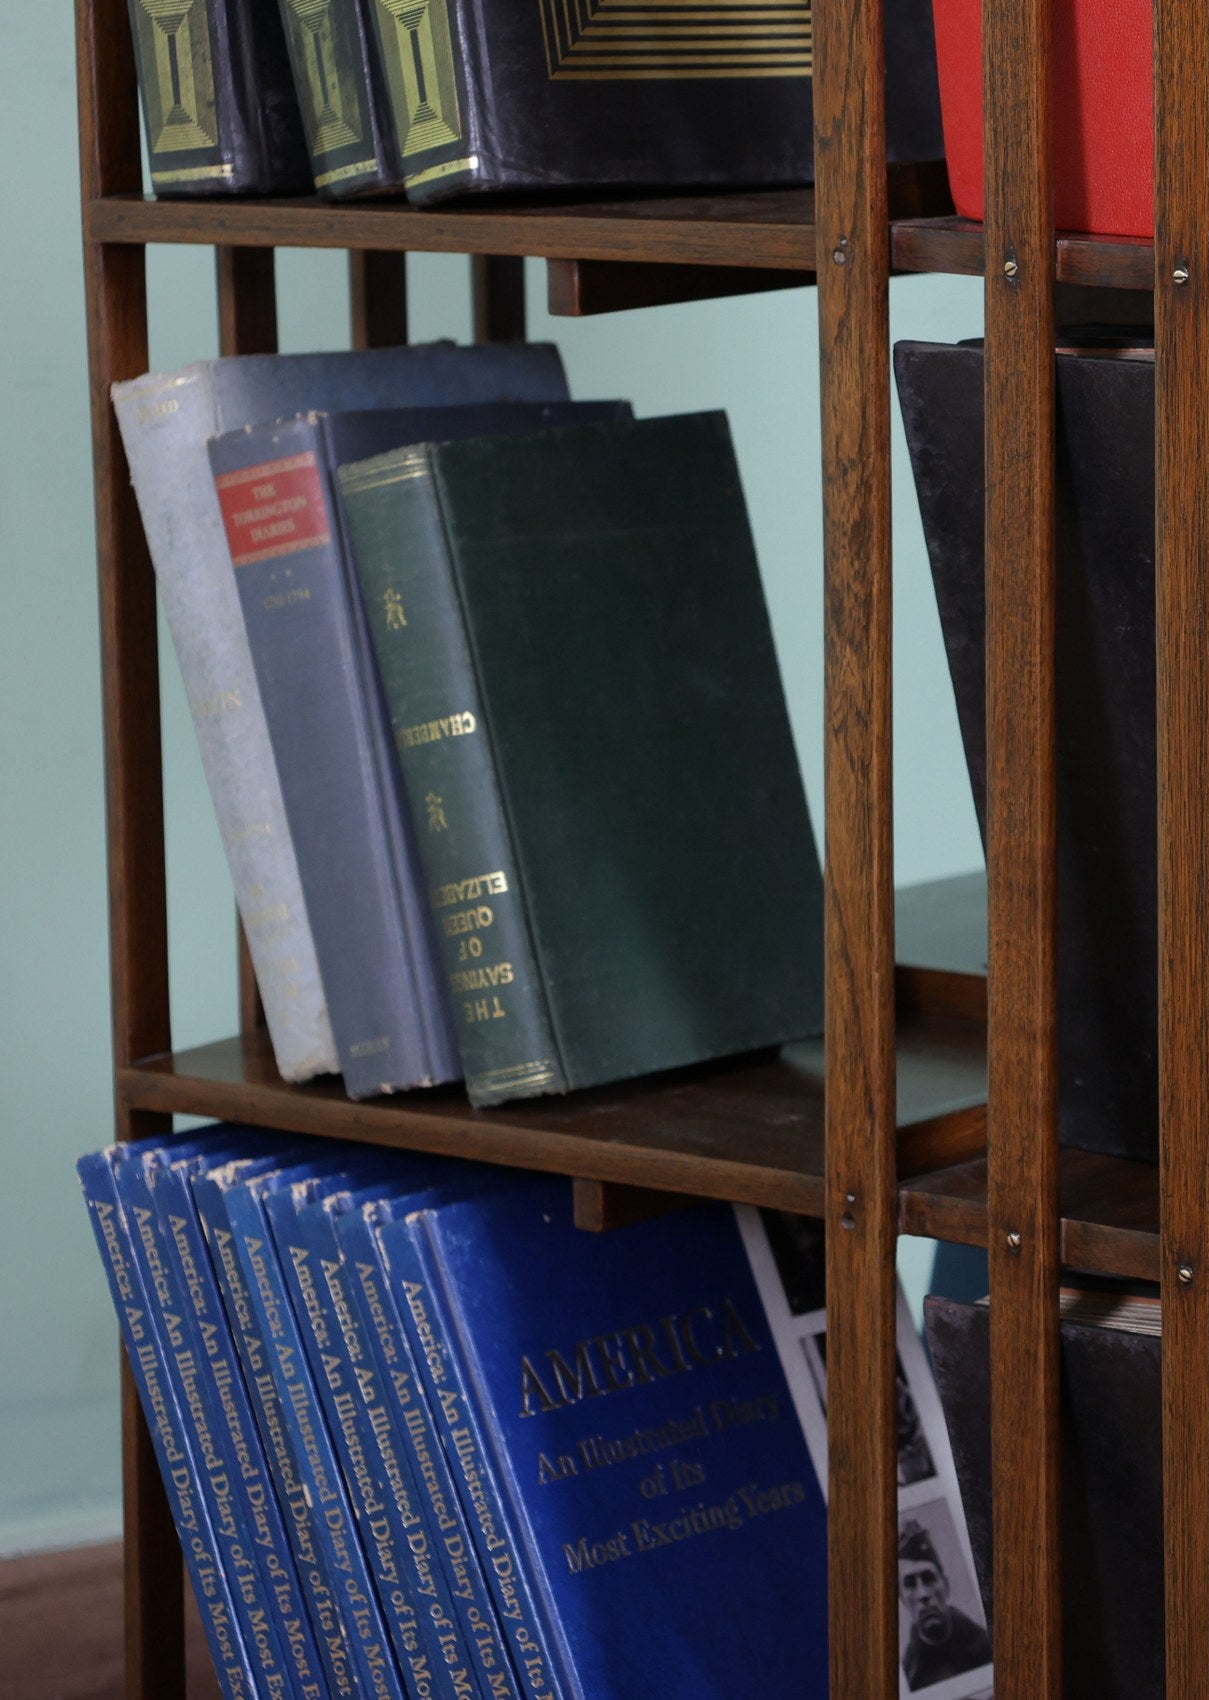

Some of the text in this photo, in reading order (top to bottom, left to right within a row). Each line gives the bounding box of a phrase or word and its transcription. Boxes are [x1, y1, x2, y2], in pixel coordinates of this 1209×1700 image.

[459, 936, 483, 962] OF
[464, 996, 506, 1025] THE
[95, 1200, 133, 1301] America:
[133, 1206, 172, 1308] America:
[168, 1214, 208, 1316] America:
[244, 1235, 285, 1339] America:
[289, 1245, 331, 1350] America:
[125, 1306, 145, 1342] An
[162, 1311, 183, 1348] An
[198, 1320, 219, 1357] An
[402, 1279, 447, 1385] America:
[275, 1343, 296, 1380] An
[321, 1353, 343, 1391] An
[517, 1297, 763, 1420] AMERICA
[137, 1344, 185, 1463] Illustrated
[175, 1351, 224, 1471] Illustrated
[210, 1359, 260, 1480] Illustrated
[436, 1388, 460, 1426] An
[213, 1228, 353, 1697] America: An Illustrated Diary of Its Most
[287, 1382, 338, 1504] Illustrated
[320, 1258, 459, 1665] America: An Illustrated Diary of Its
[333, 1392, 385, 1516] Illustrated
[355, 1260, 496, 1669] America: An Illustrated Diary of Its
[537, 1393, 780, 1486] An Illustrated Diary
[171, 1465, 200, 1533] Diary
[210, 1472, 239, 1540] Diary
[451, 1427, 507, 1552] Illustrated
[639, 1456, 707, 1500] of Its
[246, 1483, 275, 1548] Diary
[324, 1507, 352, 1573] Diary
[563, 1480, 806, 1575] Most Exciting Years
[191, 1537, 213, 1563] of
[198, 1567, 217, 1597] Its
[230, 1544, 254, 1570] of
[266, 1554, 290, 1582] of
[369, 1517, 399, 1584] Diary
[237, 1574, 256, 1604] Its
[273, 1583, 293, 1614] Its
[345, 1578, 368, 1604] of
[391, 1590, 415, 1617] of
[491, 1552, 524, 1621] Diary
[208, 1602, 235, 1661] Most
[248, 1607, 276, 1670] Most
[283, 1617, 312, 1680] Most
[352, 1607, 372, 1640] Its
[399, 1619, 418, 1652] Its
[515, 1627, 540, 1653] of
[524, 1655, 545, 1689] Its
